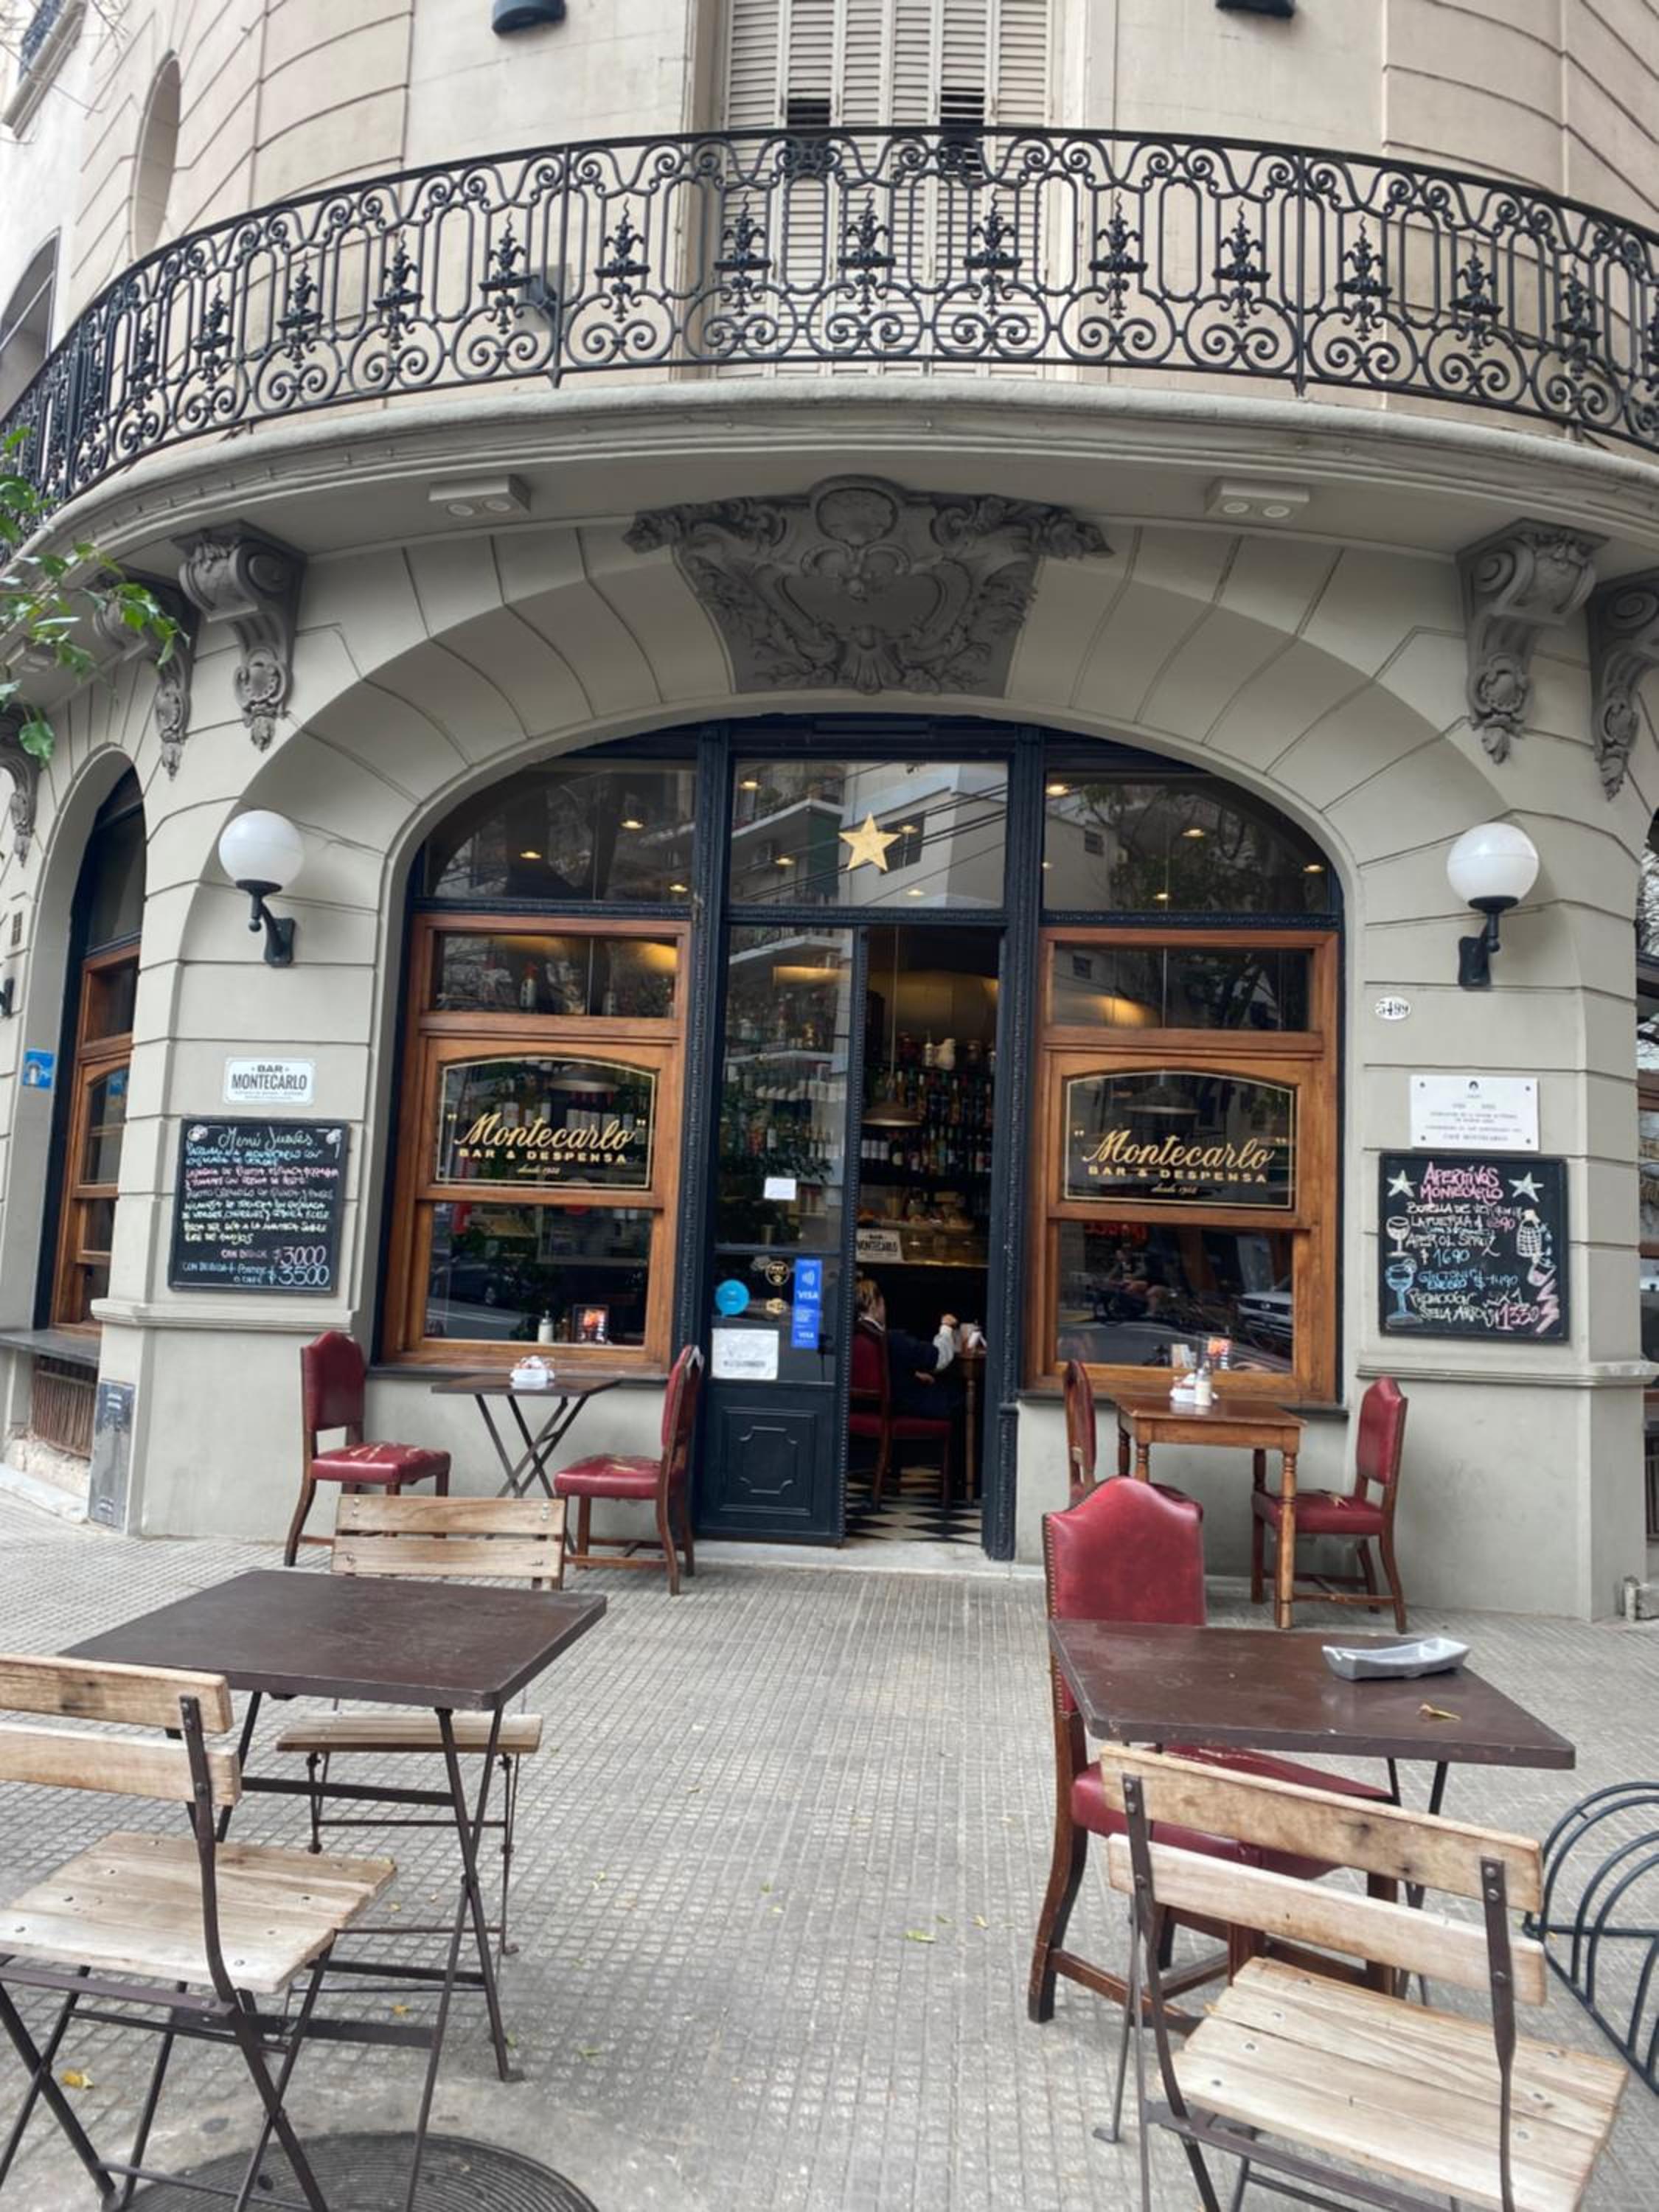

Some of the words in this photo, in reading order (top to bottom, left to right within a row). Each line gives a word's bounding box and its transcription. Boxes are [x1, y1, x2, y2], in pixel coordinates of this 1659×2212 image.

[232, 1074, 307, 1090] MONTECARLO
[459, 1149, 495, 1158] BAR
[506, 1151, 515, 1159] &
[527, 1152, 626, 1163] DESPENSA
[1088, 1166, 1126, 1176] BAR
[1138, 1167, 1148, 1177] &
[1160, 1170, 1267, 1183] DESPENSA
[279, 1245, 326, 1267] 3000
[1433, 1250, 1470, 1267] 1690
[279, 1265, 330, 1285] 3500
